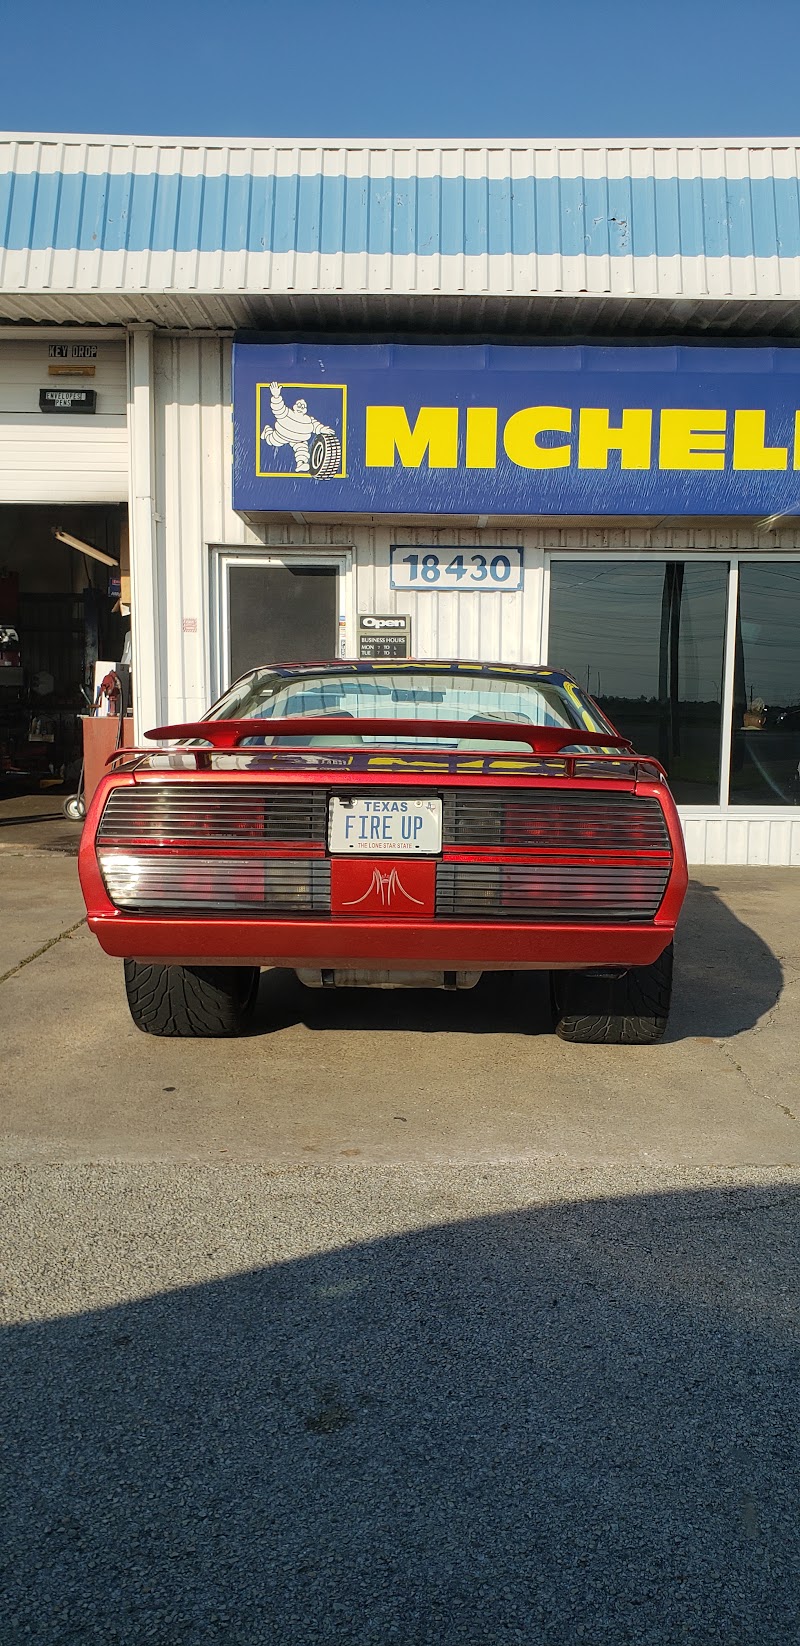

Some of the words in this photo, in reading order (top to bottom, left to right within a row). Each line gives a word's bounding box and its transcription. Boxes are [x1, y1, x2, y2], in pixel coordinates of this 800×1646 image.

[49, 345, 68, 357] KEY
[72, 345, 97, 357] DROP
[365, 405, 800, 471] MICHEL
[402, 553, 512, 584] 18430
[362, 617, 406, 629] Open
[364, 801, 408, 813] TEXAS
[345, 815, 393, 840] FIRE
[401, 815, 423, 840] UP
